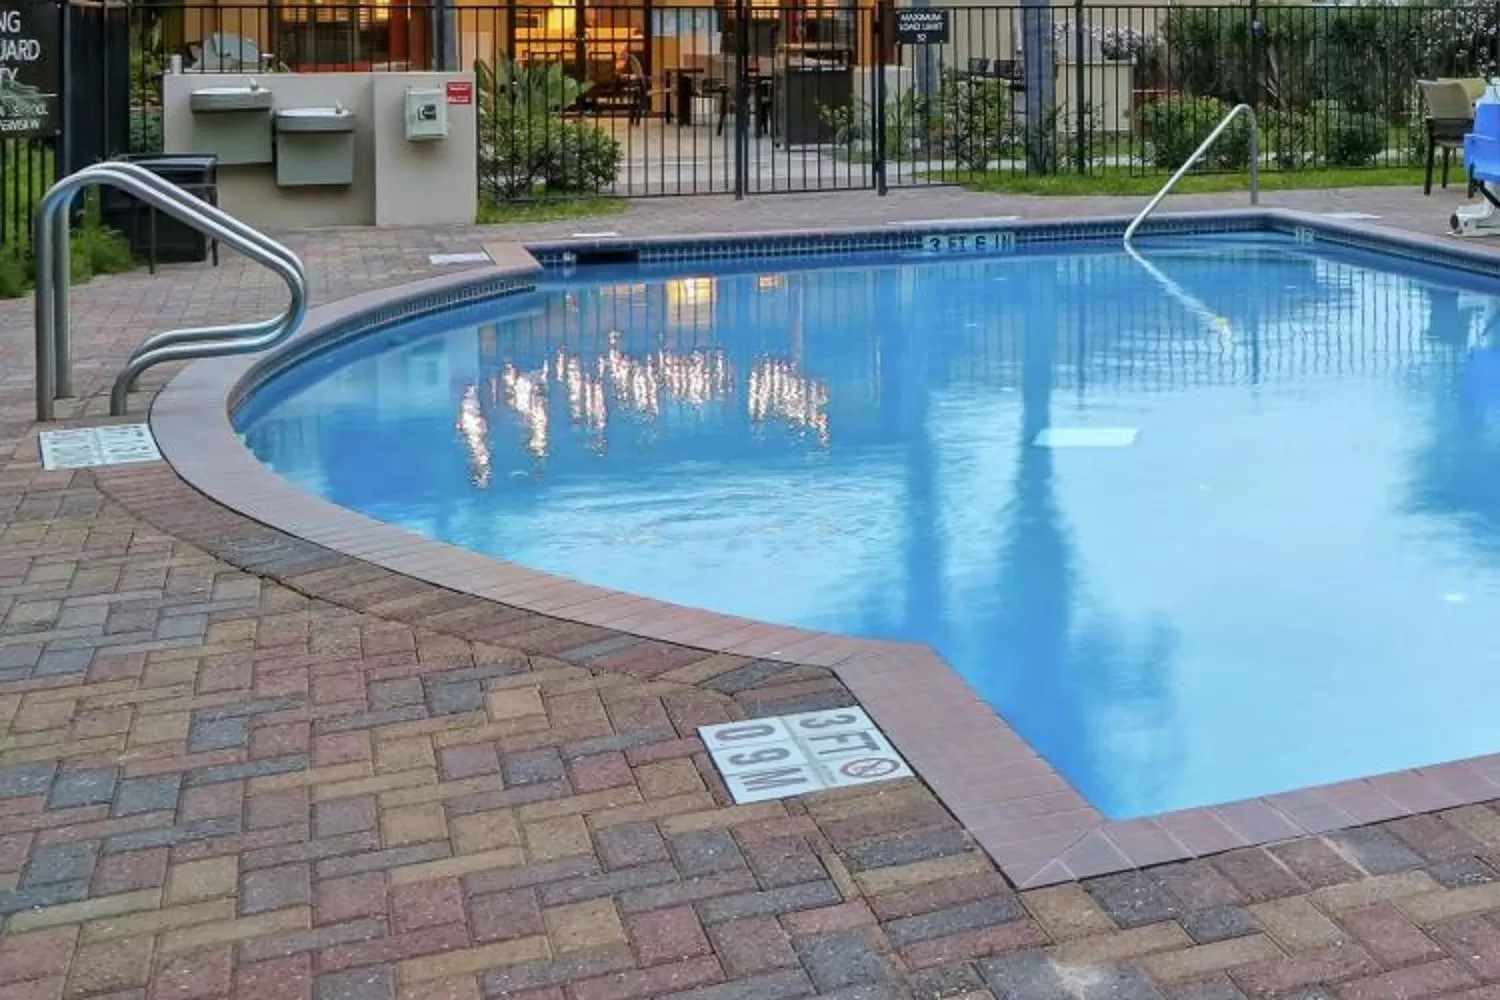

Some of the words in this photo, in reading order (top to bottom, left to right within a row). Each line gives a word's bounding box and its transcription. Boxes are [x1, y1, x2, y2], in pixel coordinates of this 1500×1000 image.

[799, 714, 857, 729] 3
[808, 730, 882, 755] FT
[740, 766, 808, 793] M
